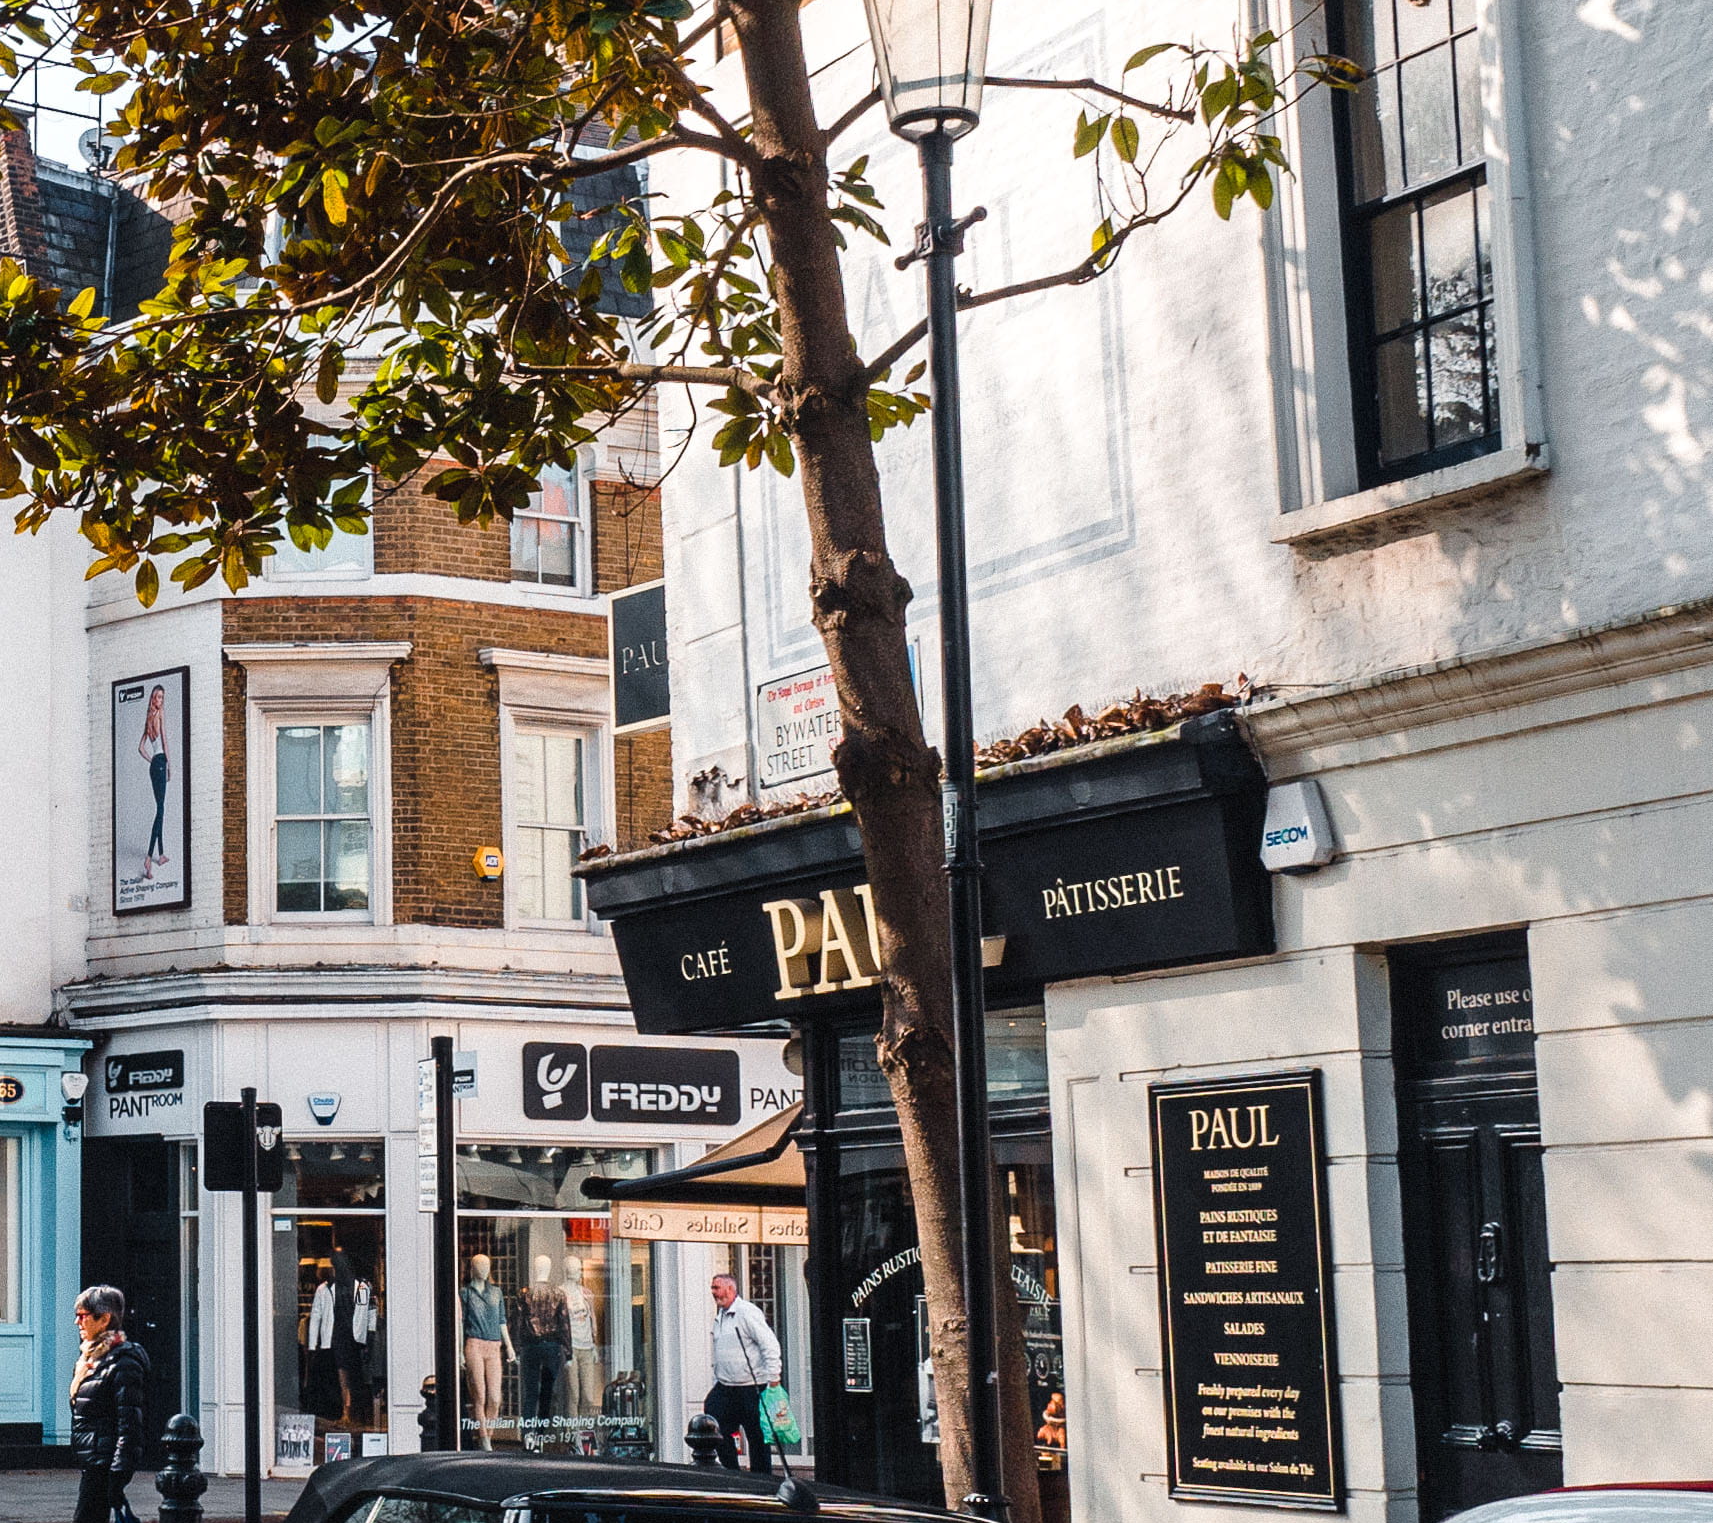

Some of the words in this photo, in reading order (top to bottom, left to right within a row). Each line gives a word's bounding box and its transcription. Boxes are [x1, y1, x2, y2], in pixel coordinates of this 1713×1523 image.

[622, 640, 667, 675] PAU
[776, 709, 841, 749] BYWATER
[1266, 825, 1308, 847] SECOM
[1042, 866, 1184, 920] PÂTISSERIE
[762, 883, 882, 1000] PA
[681, 940, 732, 981] CAFÉ
[1447, 989, 1492, 1010] Please
[1495, 990, 1520, 1005] use
[1441, 1021, 1490, 1039] corner
[1492, 1016, 1533, 1035] entra
[129, 1068, 173, 1085] FREDDY
[601, 1082, 721, 1113] FREDDY
[751, 1088, 803, 1110] PANT
[1188, 1105, 1280, 1151] PAUL
[1200, 1211, 1226, 1223] PAINS
[1227, 1209, 1278, 1224] RUSTIQUES
[1203, 1231, 1215, 1243] ET
[1216, 1231, 1229, 1243] DE
[1230, 1230, 1277, 1243] FANTAISIE
[851, 1268, 883, 1308] PAINS
[881, 1245, 922, 1280] RUSTI
[1205, 1261, 1255, 1274] PATISSERIE
[1256, 1260, 1278, 1273] FINE
[1184, 1292, 1243, 1305] SANDWICHES
[1244, 1291, 1305, 1305] ARTISANAUX
[1224, 1322, 1266, 1335] SALADES
[1213, 1352, 1280, 1367] VIENNOISERIE
[1198, 1383, 1225, 1400] Freshly
[1226, 1384, 1261, 1400] prepared
[1262, 1389, 1284, 1401] every
[1284, 1386, 1300, 1402] day
[461, 1418, 481, 1430] The
[517, 1414, 550, 1428] Active
[552, 1414, 595, 1430] Shaping
[597, 1414, 646, 1428] Company
[1202, 1406, 1212, 1416] on
[1213, 1407, 1227, 1416] our
[1228, 1406, 1262, 1420] premises
[1263, 1406, 1281, 1419] with
[1282, 1407, 1296, 1419] the
[559, 1431, 577, 1443] 197
[1202, 1423, 1224, 1438] finest
[1225, 1426, 1254, 1437] natural
[1255, 1426, 1299, 1442] ingredients
[1192, 1457, 1217, 1471] Seating
[1218, 1459, 1247, 1471] available
[1247, 1461, 1255, 1471] in
[1256, 1463, 1268, 1472] our
[1269, 1462, 1289, 1474] Salon
[1289, 1464, 1299, 1475] de
